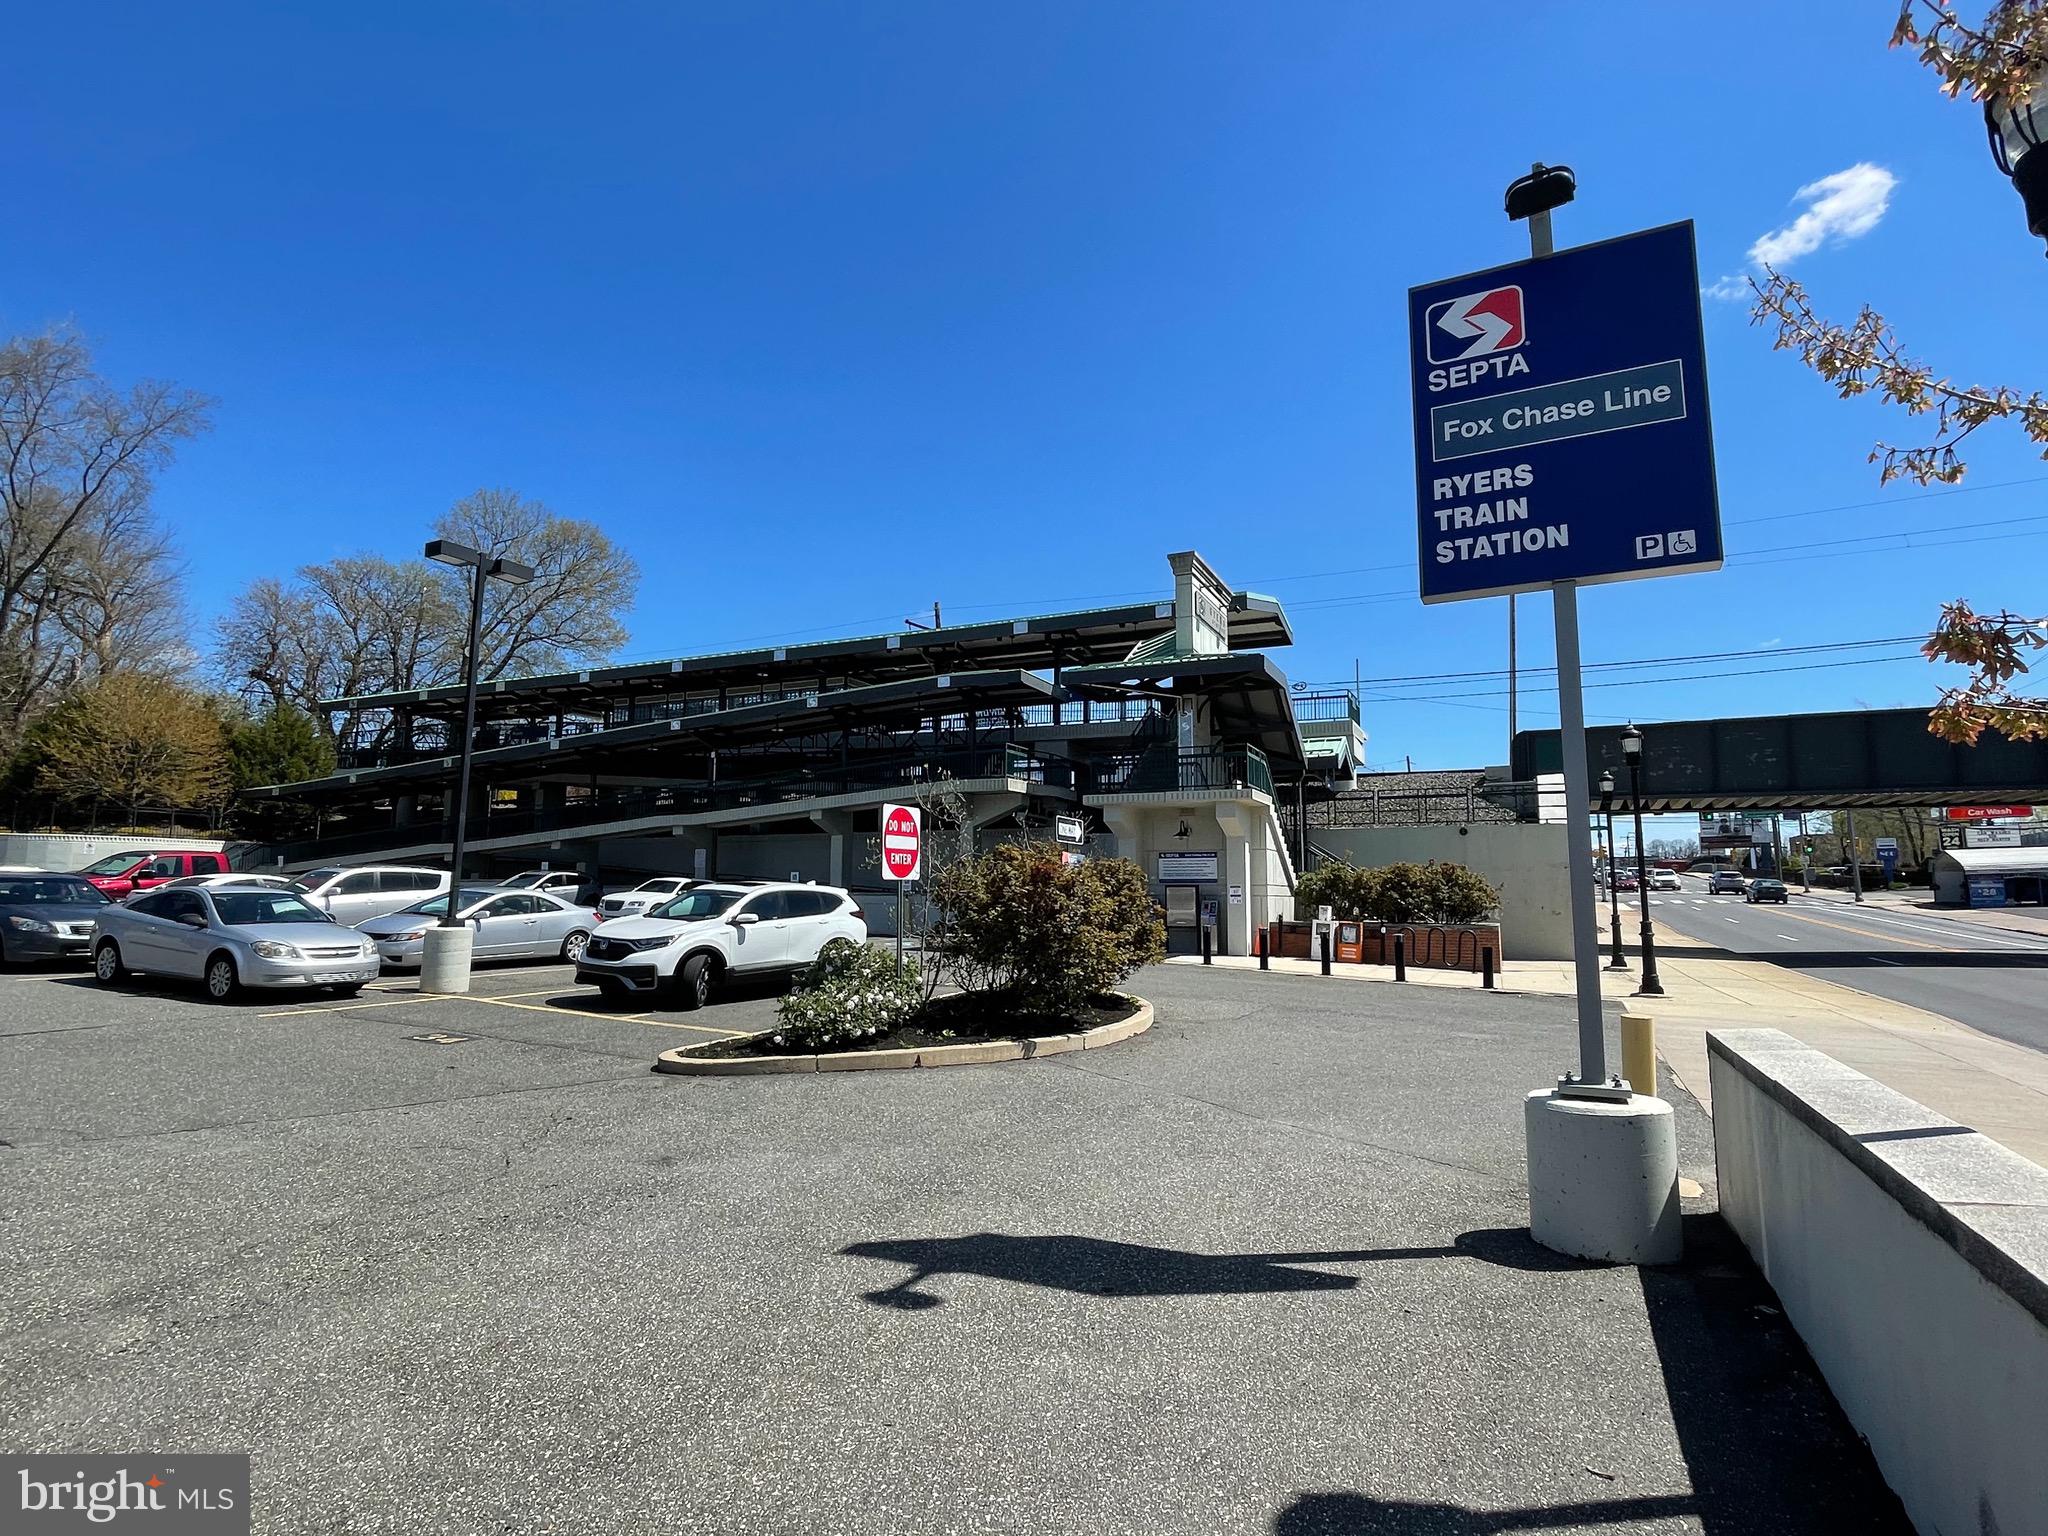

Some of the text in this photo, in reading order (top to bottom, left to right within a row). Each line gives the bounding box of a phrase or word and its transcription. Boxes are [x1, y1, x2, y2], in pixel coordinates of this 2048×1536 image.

[1428, 352, 1530, 392] SEPTA
[1443, 384, 1672, 442] Fox Chase Line
[1433, 463, 1534, 500] RYERS
[1434, 497, 1529, 531] TRAIN
[1436, 524, 1569, 564] STATION
[1641, 537, 1660, 557] P
[1967, 807, 2013, 816] Car Wash
[888, 819, 915, 833] DO NOT
[1942, 837, 1961, 846] 24
[890, 852, 912, 865] ENTER
